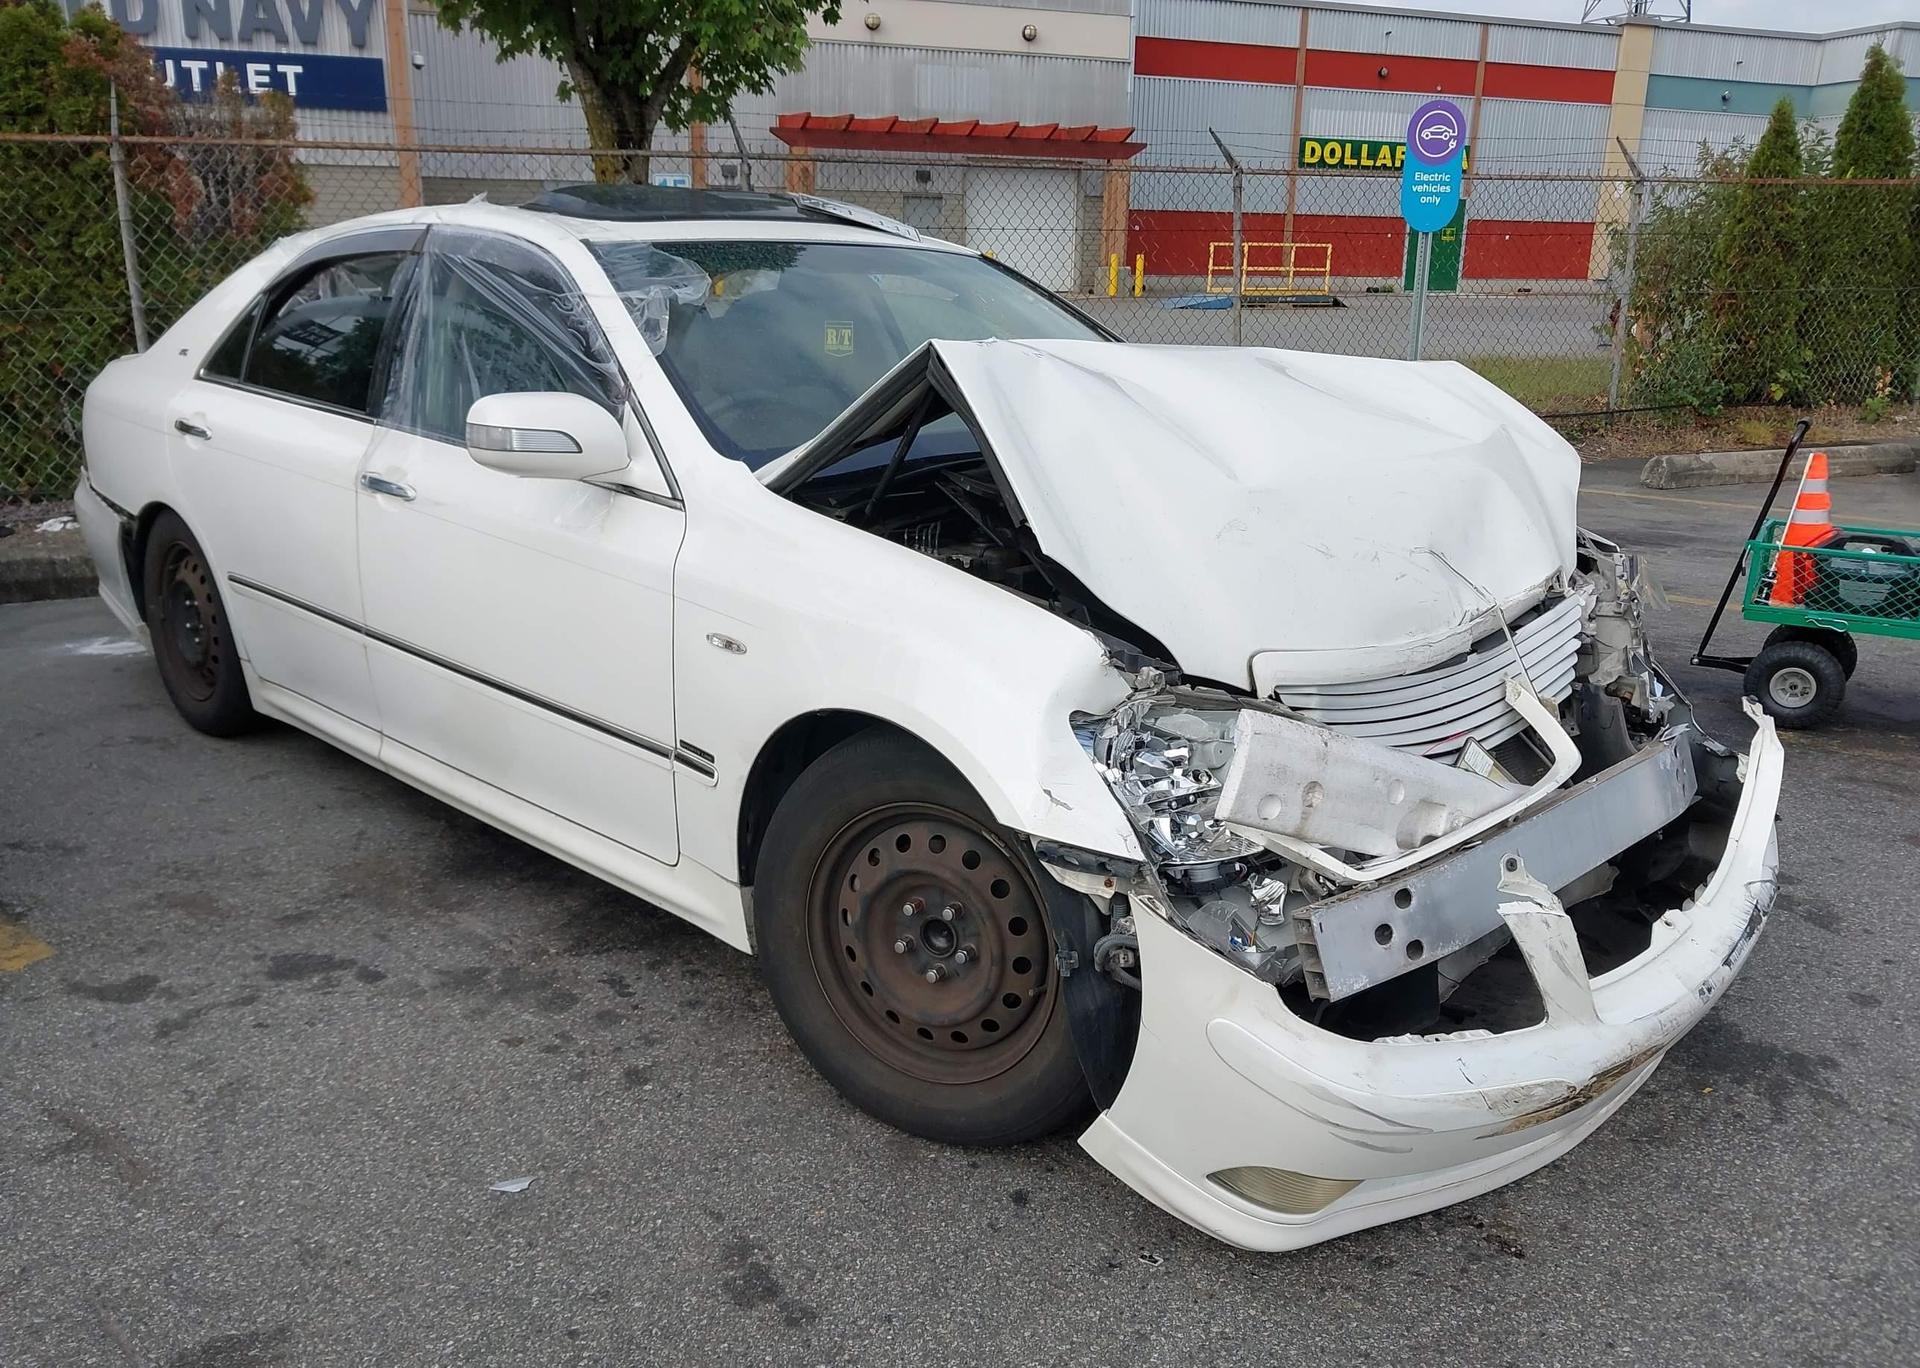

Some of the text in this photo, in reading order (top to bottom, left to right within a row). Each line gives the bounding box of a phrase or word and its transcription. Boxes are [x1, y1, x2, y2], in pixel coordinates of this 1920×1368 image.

[182, 0, 373, 47] NAVY
[1414, 172, 1451, 182] Electric
[1412, 183, 1451, 193] vehicles
[1420, 195, 1441, 205] only
[826, 328, 852, 345] R/T
